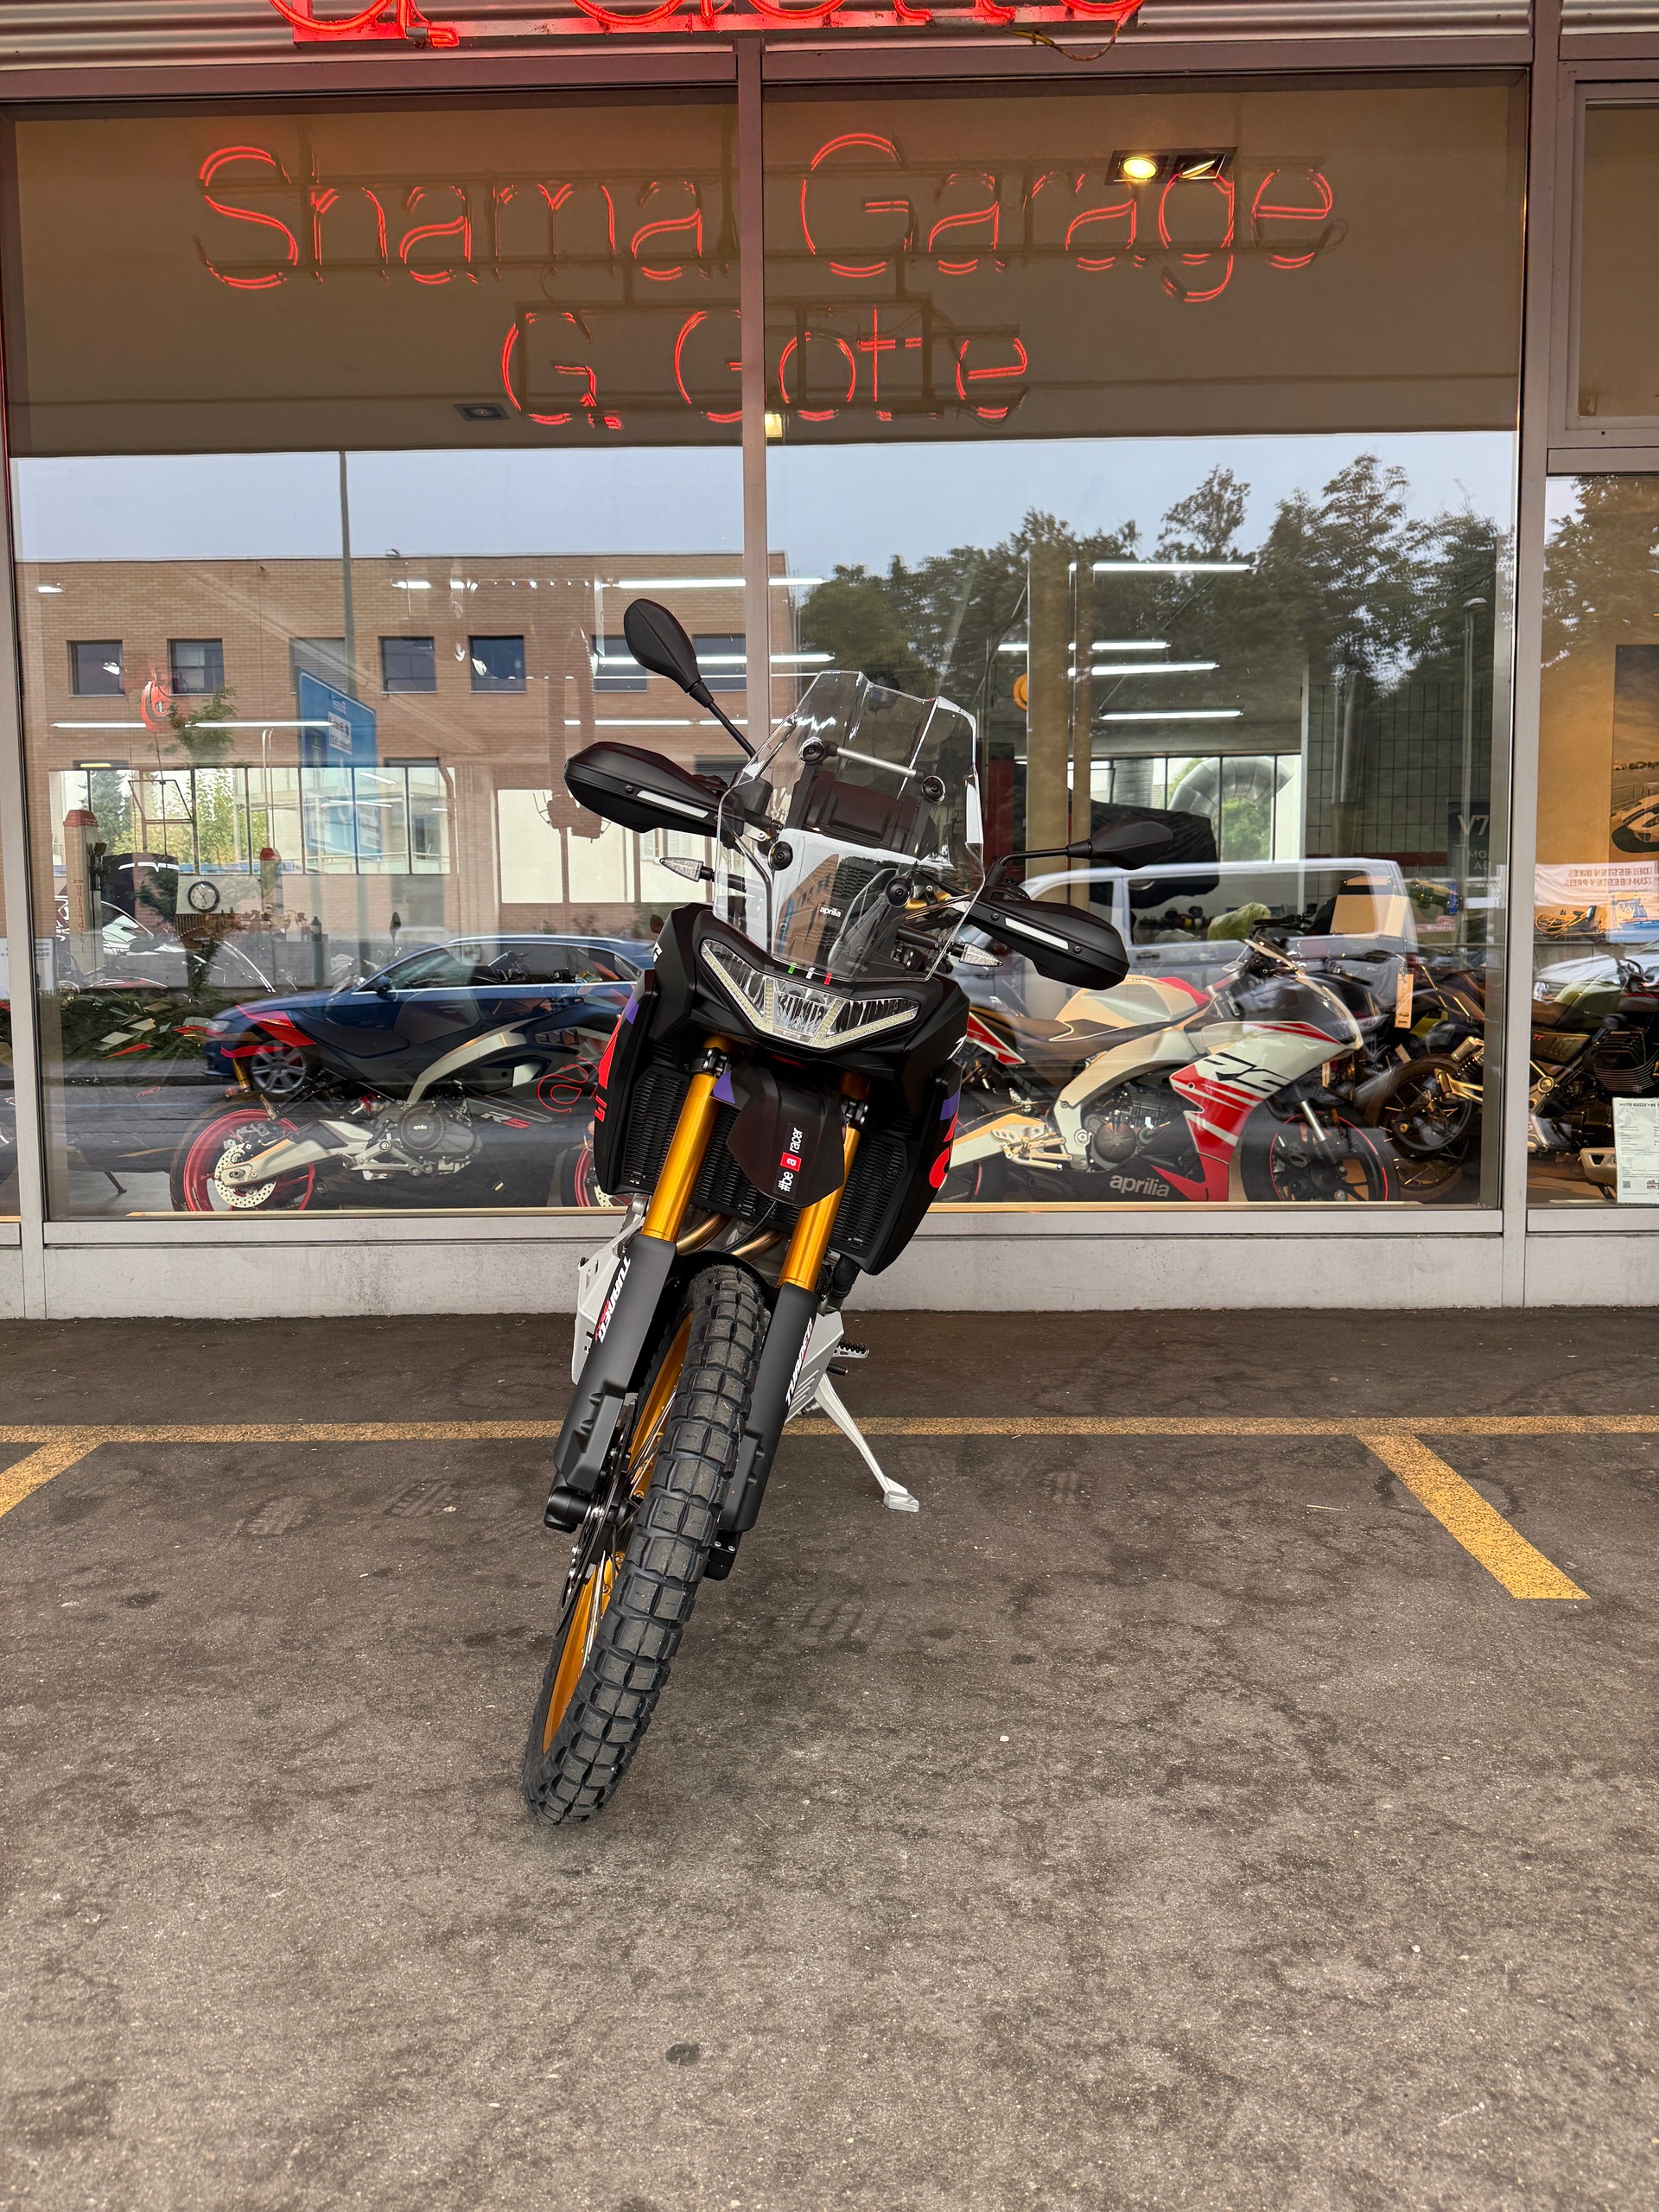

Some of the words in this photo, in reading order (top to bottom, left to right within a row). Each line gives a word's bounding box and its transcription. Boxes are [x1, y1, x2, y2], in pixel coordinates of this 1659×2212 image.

[800, 132, 1333, 302] Garage
[1457, 815, 1490, 836] V7
[819, 906, 842, 918] aprilia
[480, 1111, 534, 1129] RS
[789, 1127, 804, 1154] racer
[786, 1158, 798, 1166] a
[778, 1171, 794, 1192] #be
[1109, 1174, 1170, 1198] aprilia
[598, 1255, 632, 1344] TUAREG
